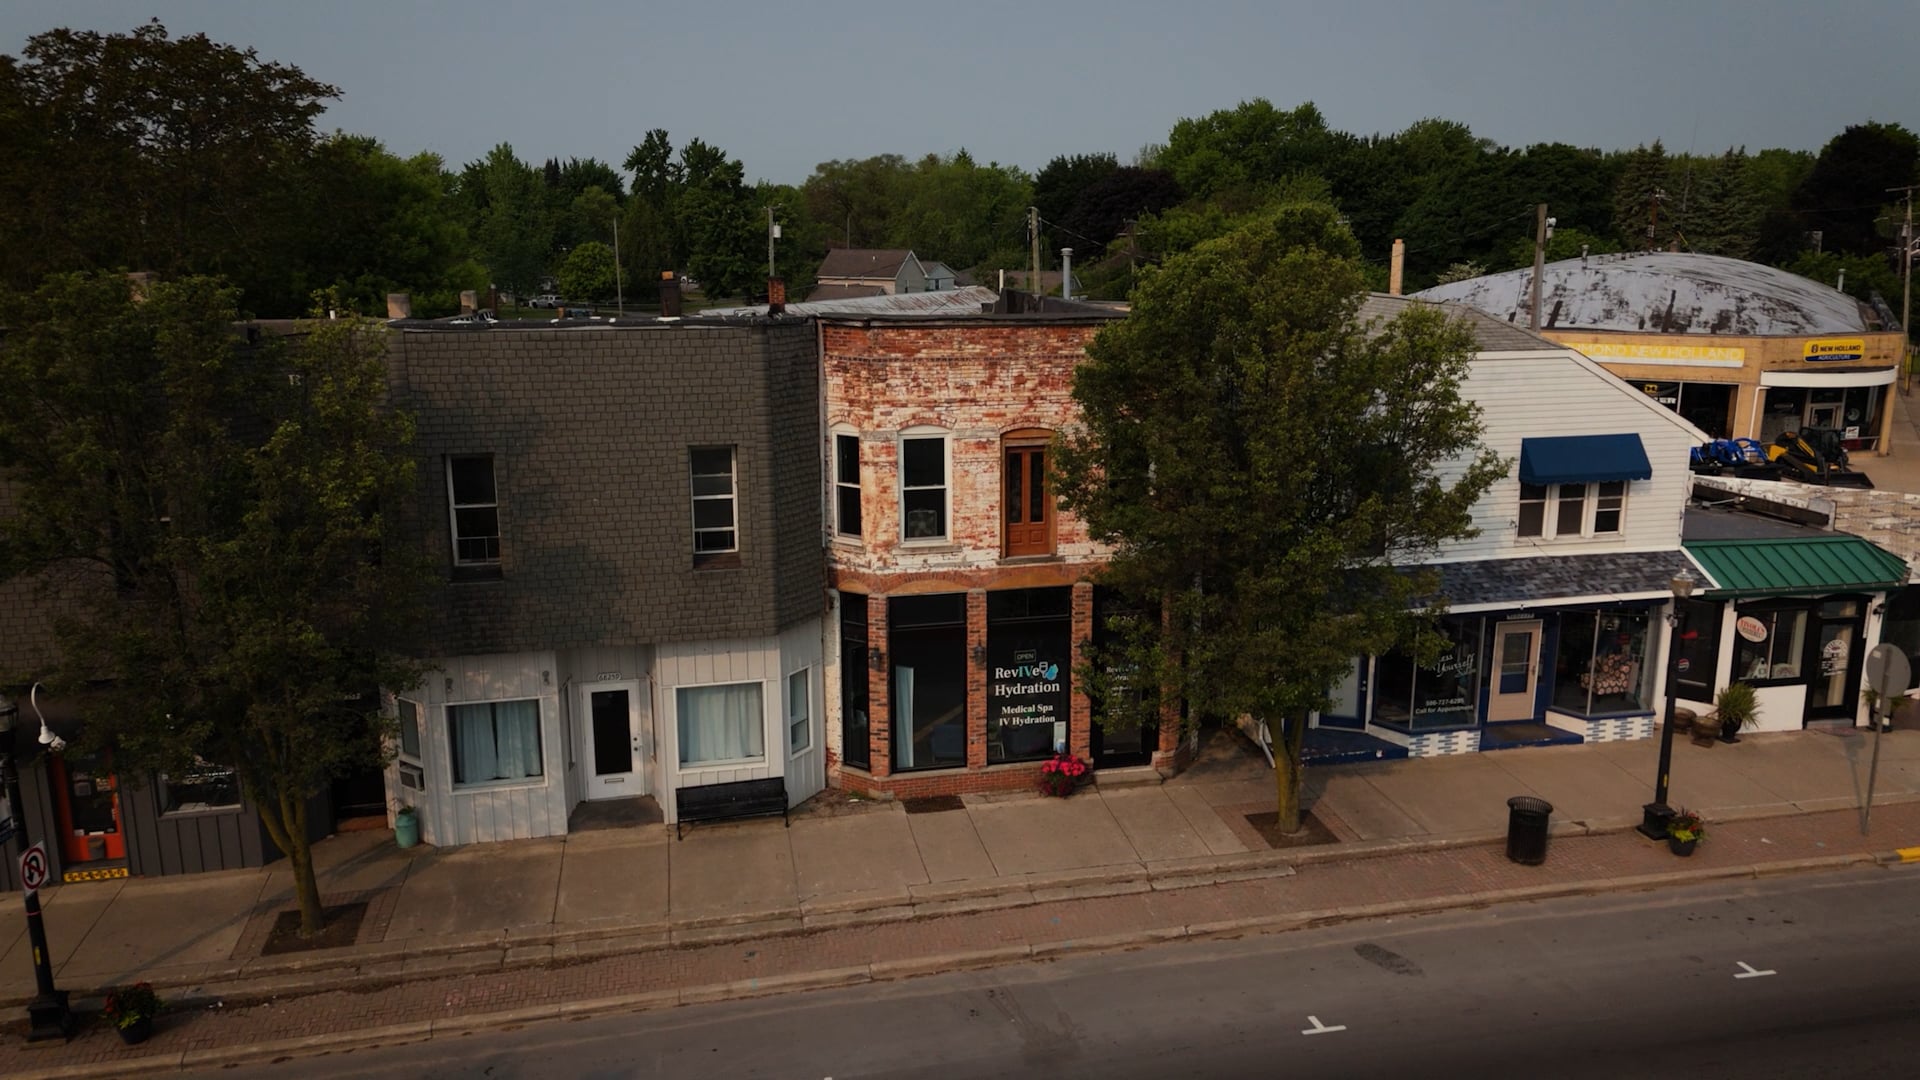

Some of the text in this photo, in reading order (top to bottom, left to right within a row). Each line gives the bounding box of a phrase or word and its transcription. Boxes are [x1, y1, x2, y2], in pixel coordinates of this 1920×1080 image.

[1630, 344, 1662, 357] NEW
[1668, 346, 1741, 360] HOLLAND
[994, 665, 1040, 680] RevIVe
[994, 681, 1060, 698] Hydration
[1001, 703, 1054, 714] Medical Spa
[1416, 706, 1427, 714] Call
[1437, 704, 1474, 713] Appointment
[999, 714, 1056, 727] IV Hydration
